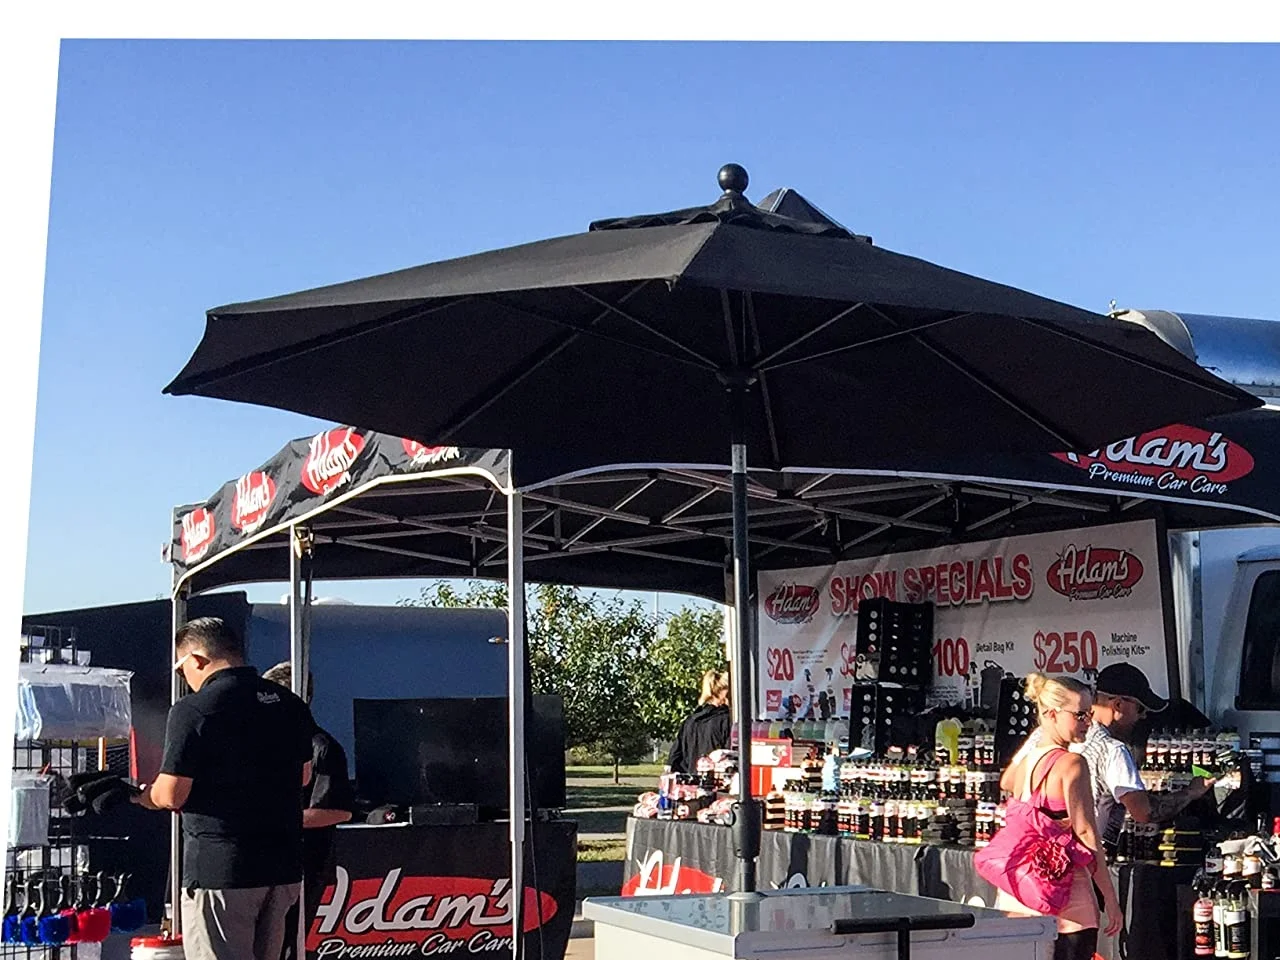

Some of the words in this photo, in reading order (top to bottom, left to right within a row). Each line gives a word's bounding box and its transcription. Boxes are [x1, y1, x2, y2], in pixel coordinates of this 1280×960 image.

[1067, 432, 1227, 472] dam's
[1089, 463, 1154, 486] Premium
[1156, 471, 1187, 491] Car
[1190, 475, 1229, 494] Care
[1057, 543, 1130, 590] Adam's
[829, 570, 898, 616] SHOW
[903, 553, 1033, 606] SPECIALS
[975, 643, 992, 653] Detail
[993, 642, 1004, 654] Bag
[1004, 640, 1015, 651] Kit
[1033, 630, 1098, 673] $250
[1101, 645, 1130, 657] Polishing
[1112, 632, 1138, 643] Machine
[767, 647, 794, 681] $20
[932, 637, 970, 677] 100
[421, 933, 463, 957] Car
[468, 930, 515, 954] Care
